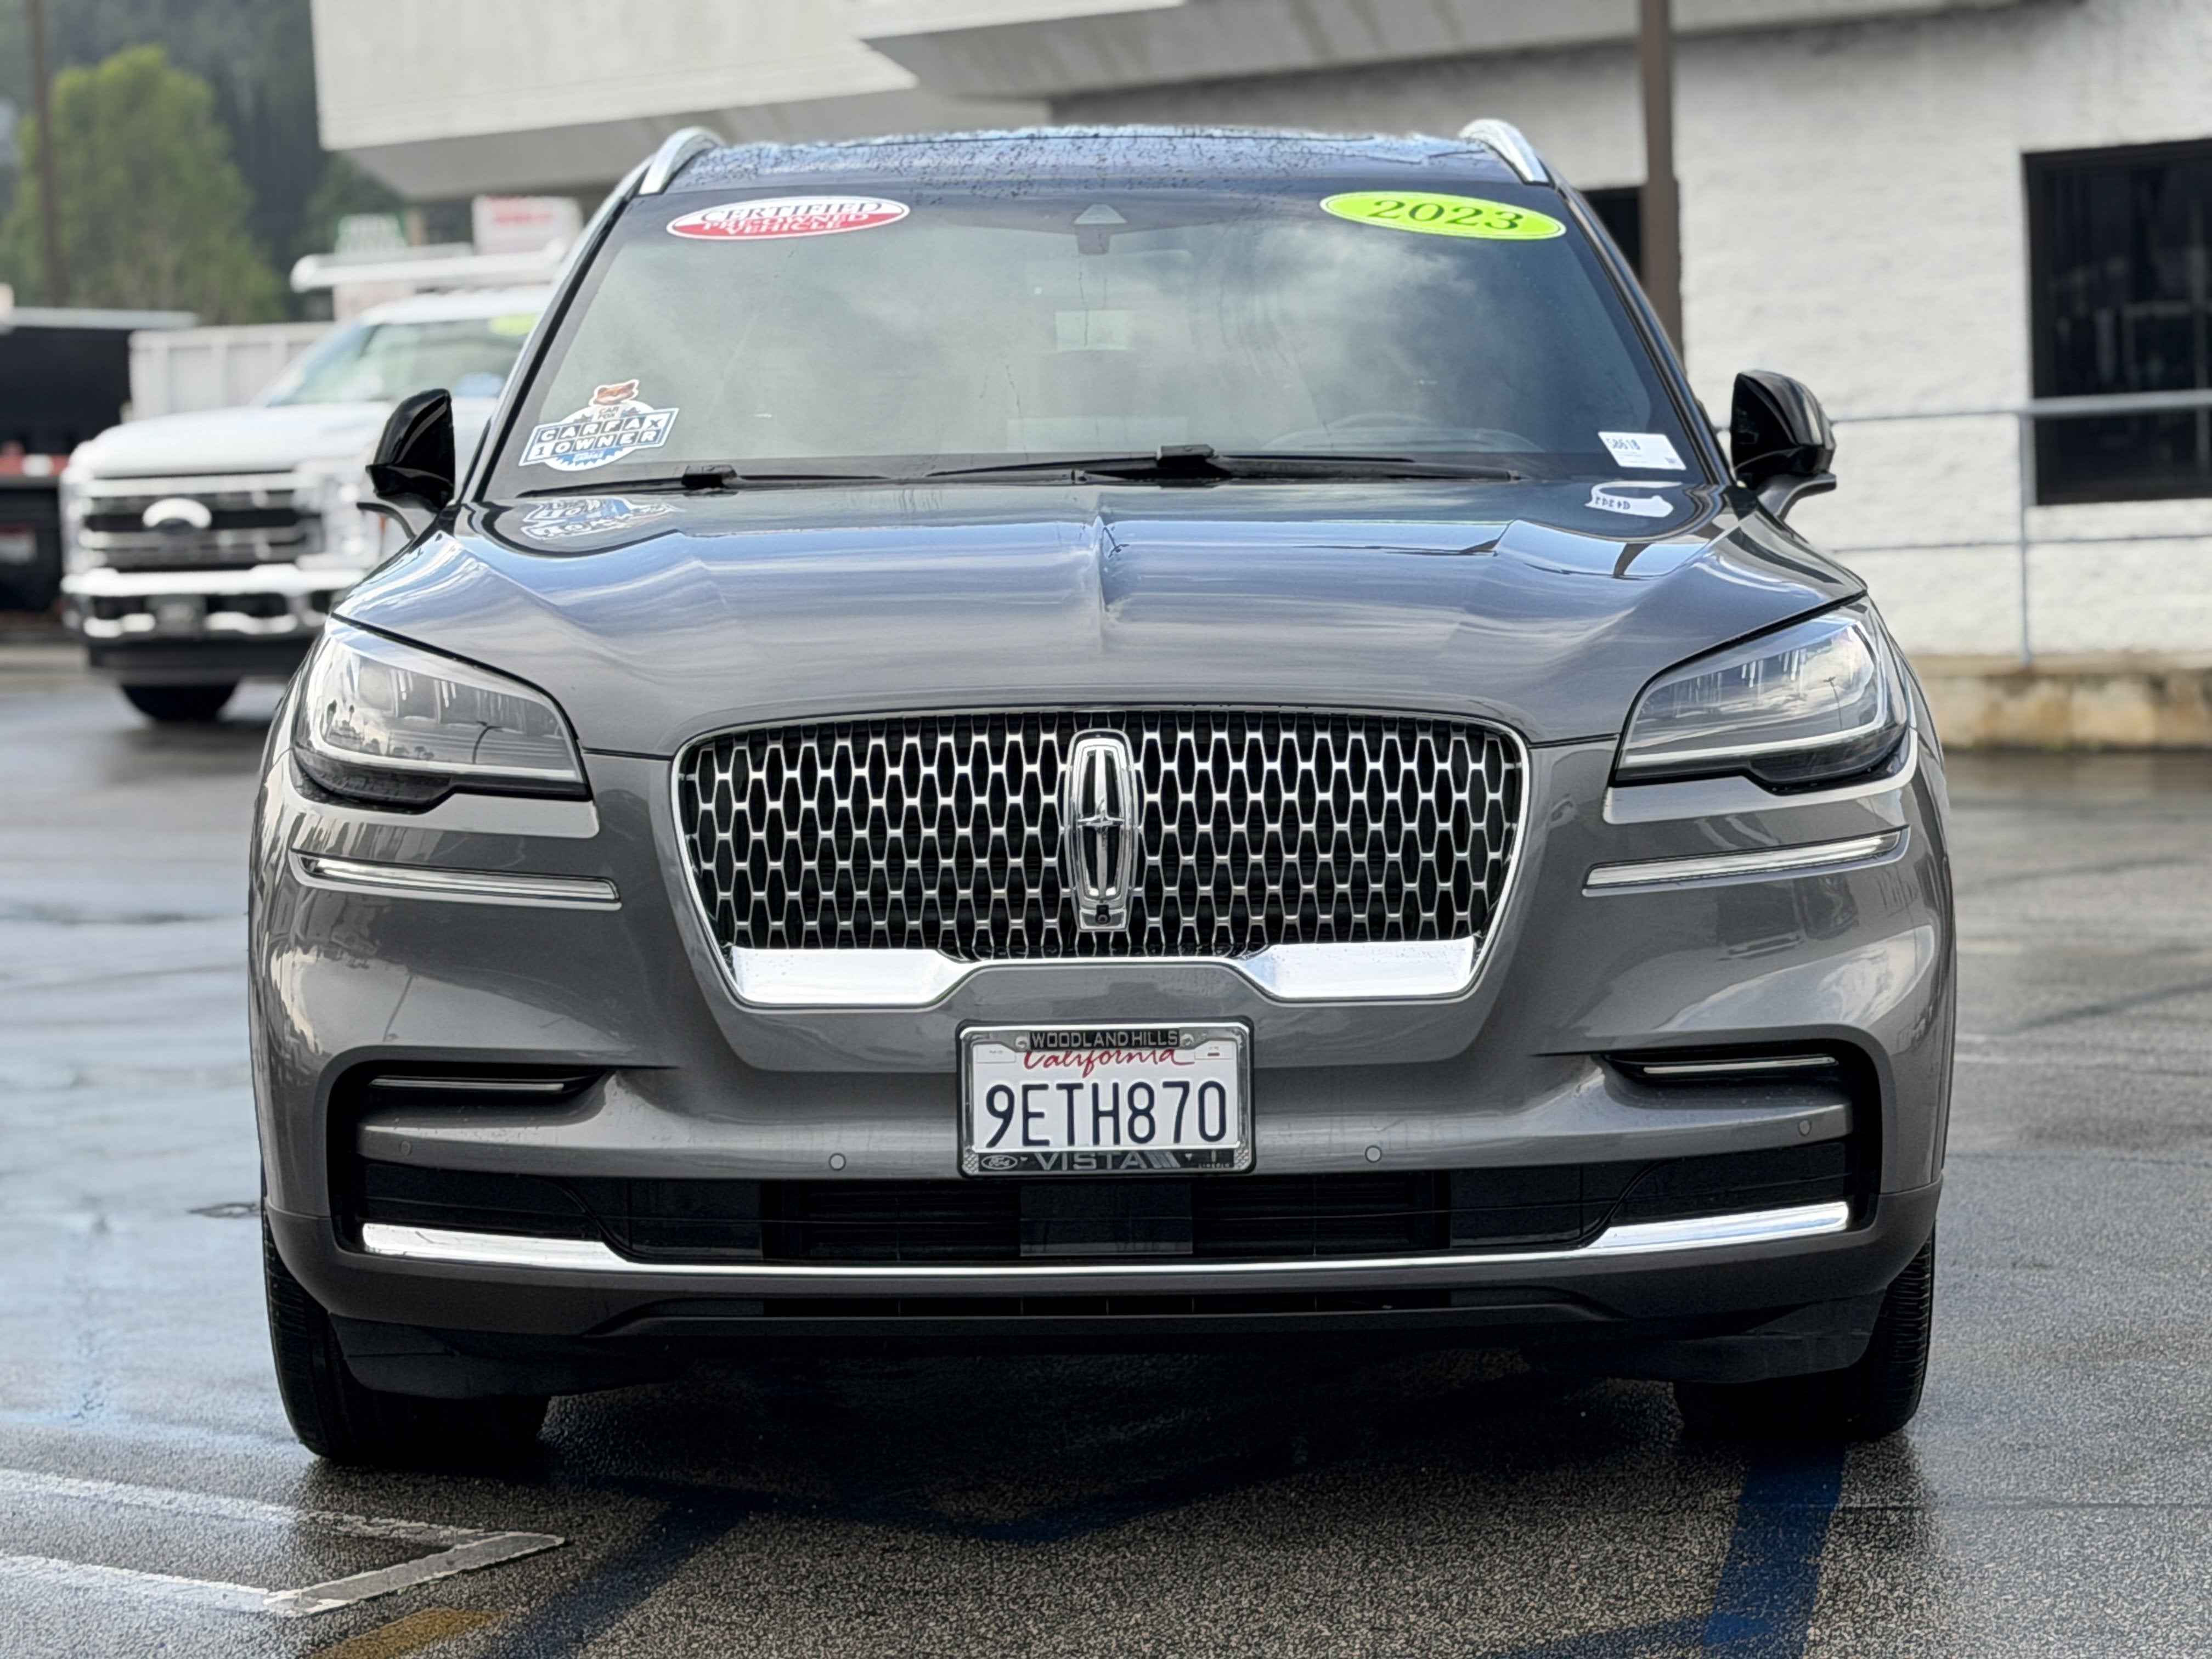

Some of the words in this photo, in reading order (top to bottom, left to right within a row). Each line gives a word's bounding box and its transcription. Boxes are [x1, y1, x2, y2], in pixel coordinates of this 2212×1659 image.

[701, 202, 883, 222] CERTIFIED
[1366, 200, 1523, 230] 2023
[726, 221, 842, 235] VEHICLE
[540, 417, 663, 442] CARFAX
[534, 445, 545, 456] 1
[554, 431, 658, 454] OWNER
[1031, 1031, 1128, 1048] WOODLAND
[1133, 1030, 1178, 1047] HILLS
[1024, 1048, 1195, 1078] California
[985, 1080, 1227, 1148] 9ETH870
[1035, 1153, 1148, 1170] VISTA
